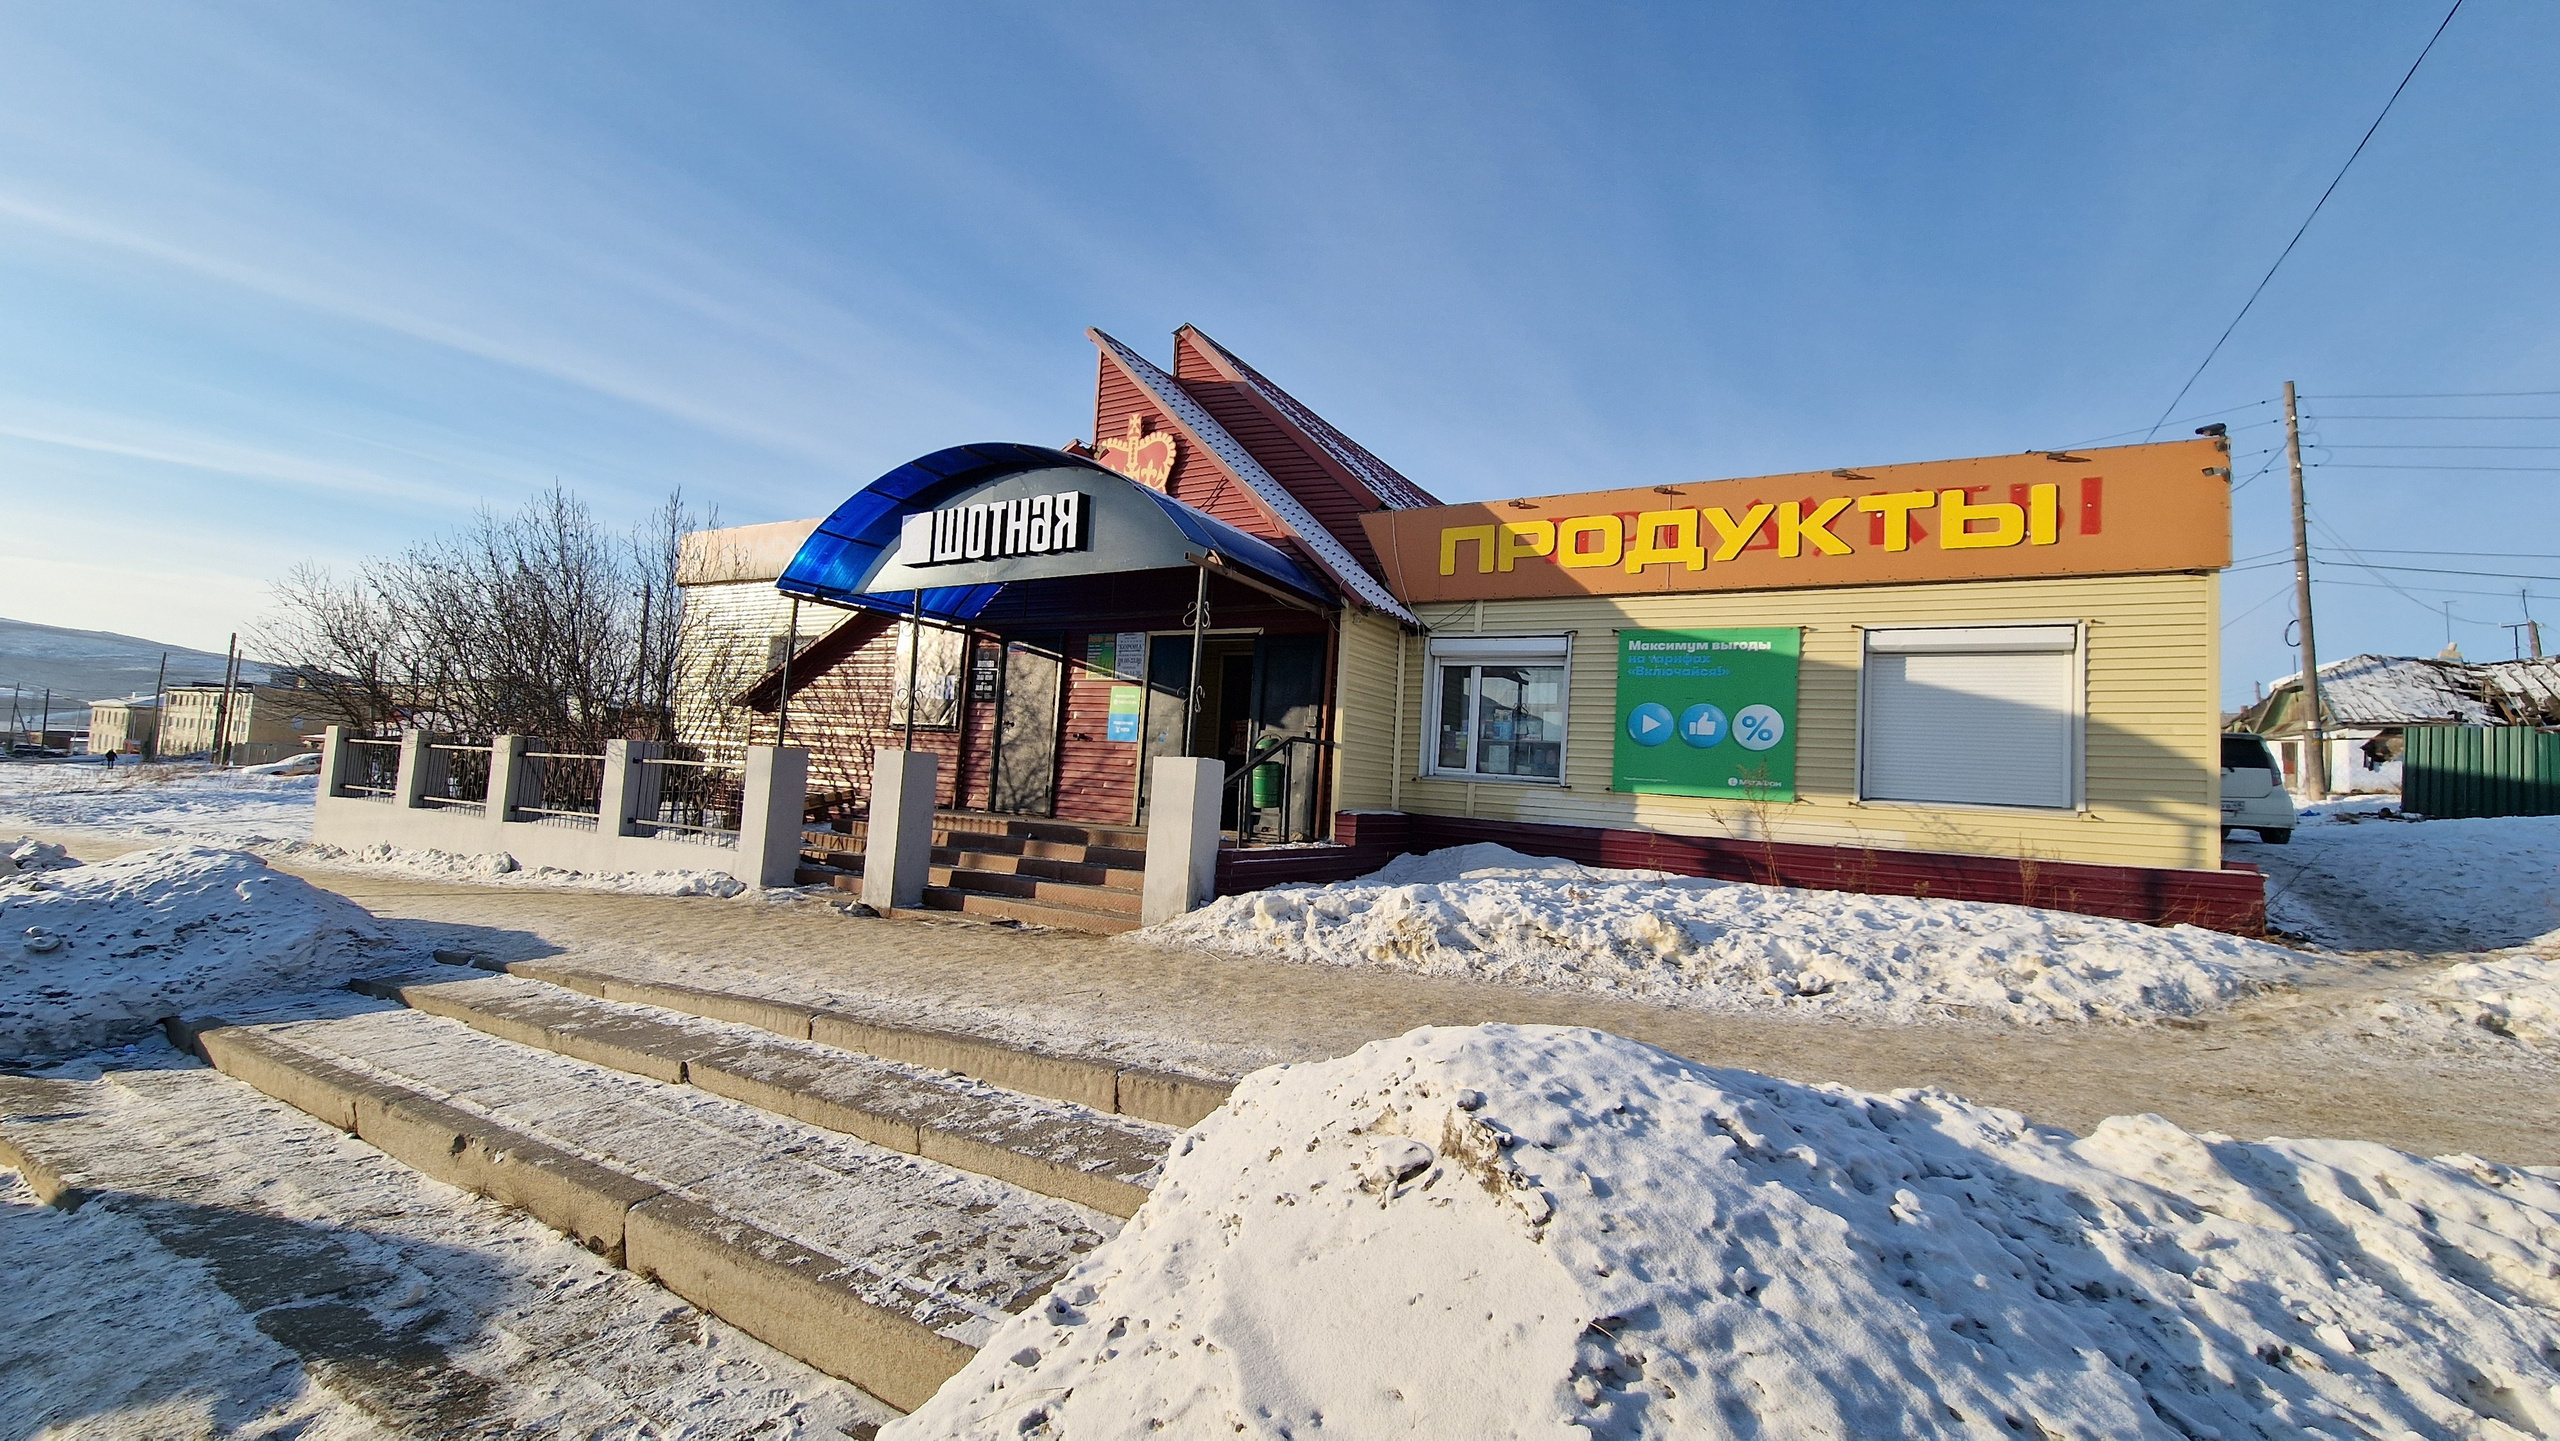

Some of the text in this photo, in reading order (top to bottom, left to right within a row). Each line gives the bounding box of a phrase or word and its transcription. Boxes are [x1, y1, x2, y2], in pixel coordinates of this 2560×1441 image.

[1440, 483, 2057, 576] ПРОДУКТЫ
[1628, 640, 1771, 653] Максимум выгоды
[1628, 653, 1711, 666] на тарифах
